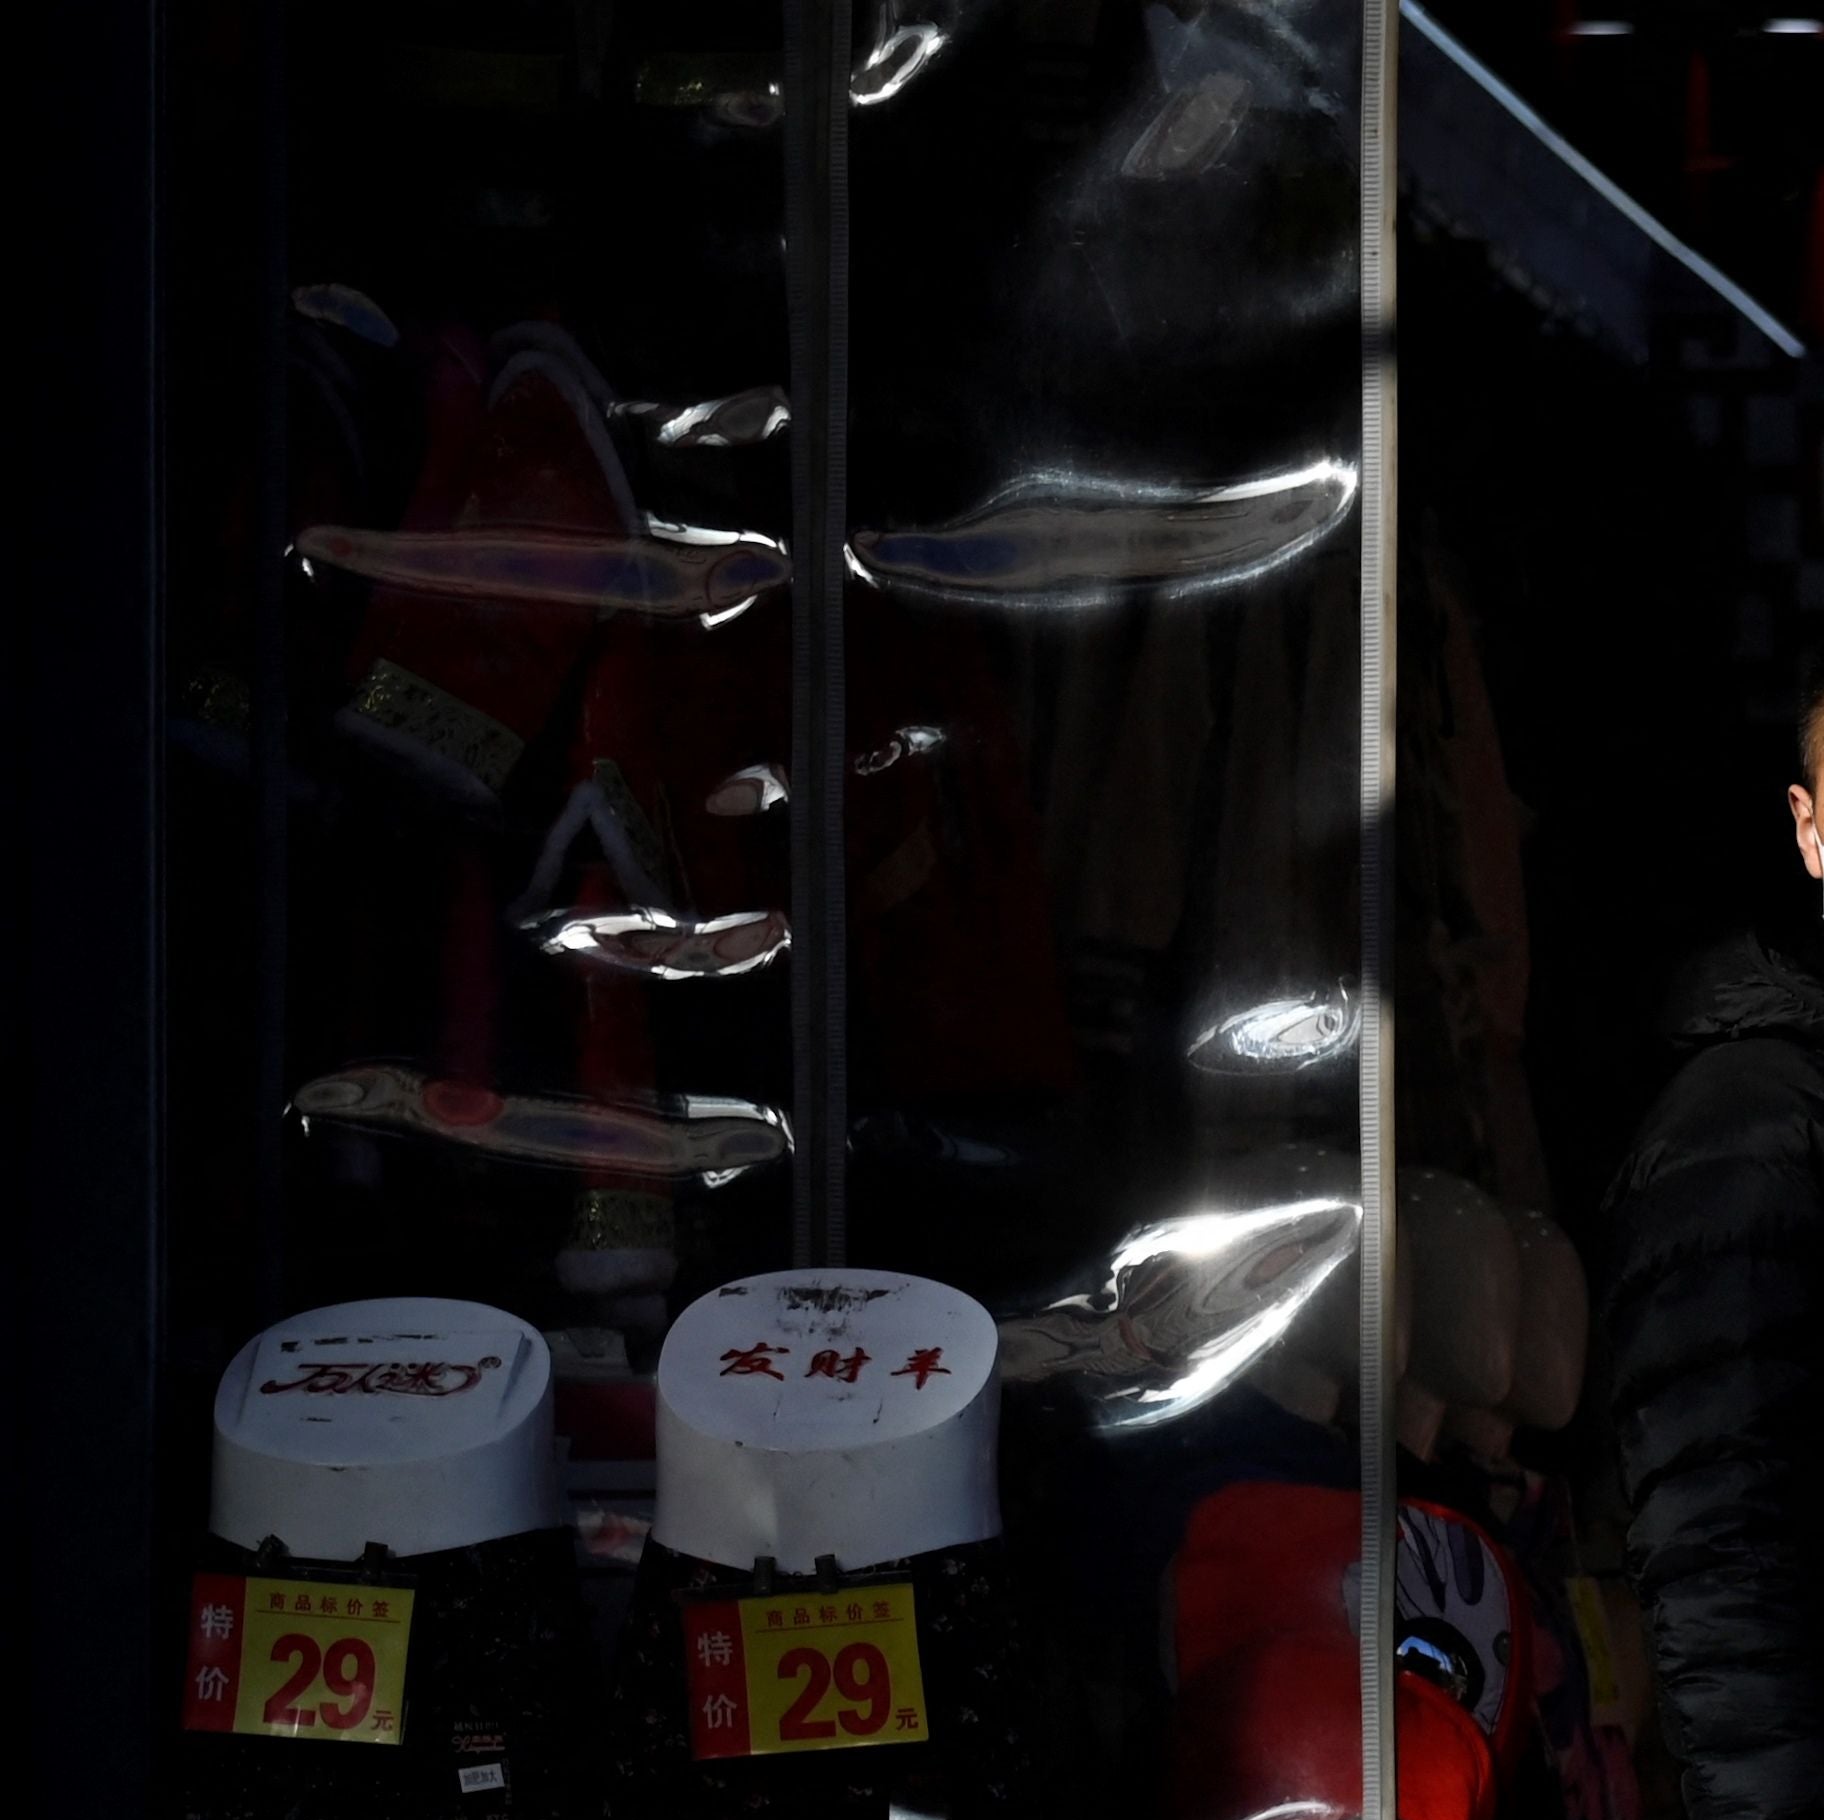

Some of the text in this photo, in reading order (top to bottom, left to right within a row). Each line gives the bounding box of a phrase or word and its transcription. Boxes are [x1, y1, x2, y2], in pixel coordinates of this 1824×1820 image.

[269, 1591, 390, 1618] 商品标价签
[767, 1603, 892, 1627] 商品标价签
[194, 1602, 234, 1703] 特价
[699, 1632, 738, 1730] 特价
